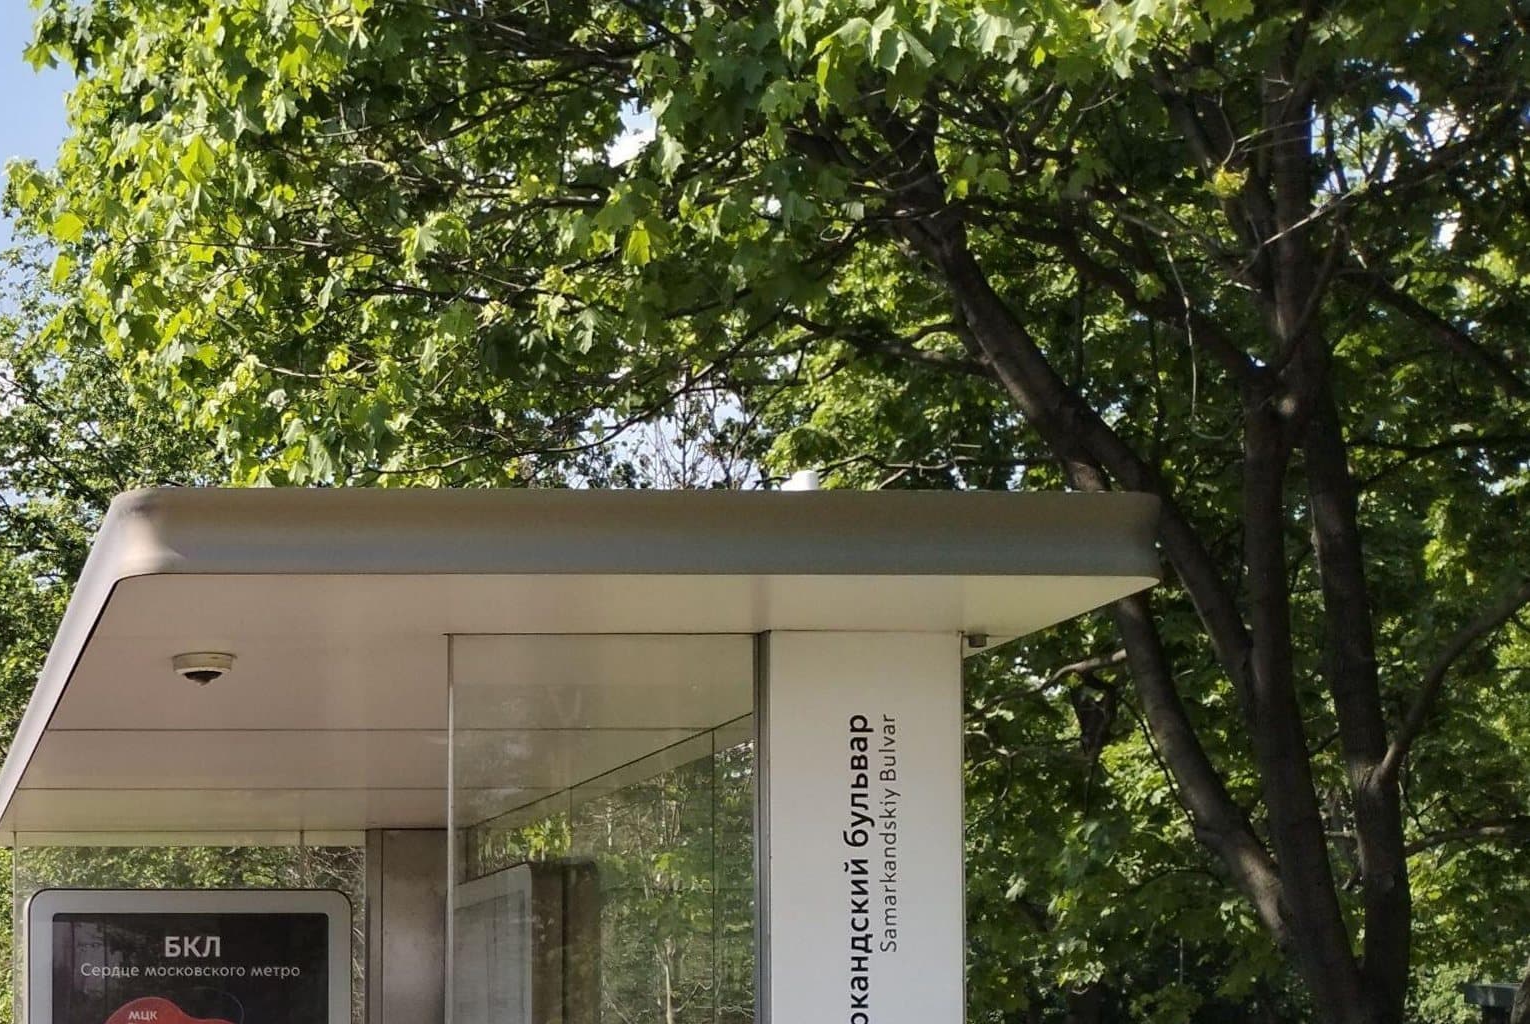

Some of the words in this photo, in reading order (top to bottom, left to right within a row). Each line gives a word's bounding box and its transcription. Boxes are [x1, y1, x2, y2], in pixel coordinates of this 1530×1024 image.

[879, 714, 897, 782] Bulvar
[843, 714, 875, 847] бульвар
[879, 788, 901, 953] Samarkandskiy
[164, 935, 221, 958] БКЛ
[80, 962, 139, 979] Сердце
[144, 966, 246, 977] московского
[250, 966, 301, 979] метро
[128, 1010, 158, 1021] МЦК
